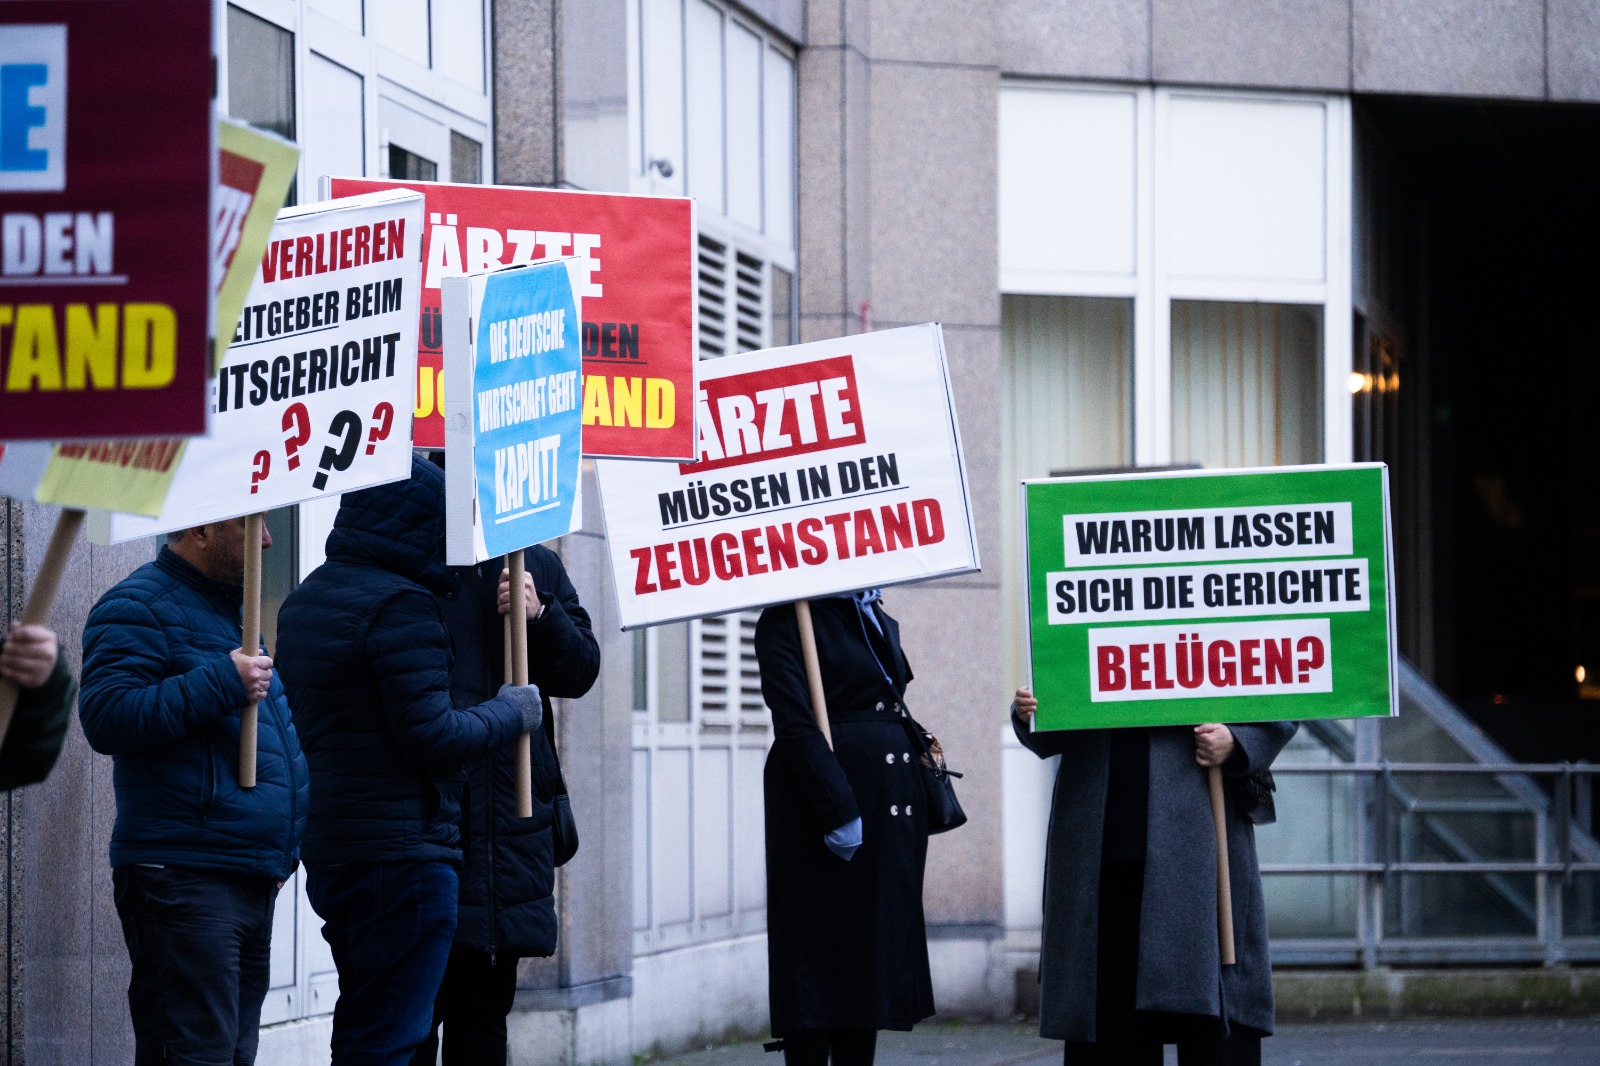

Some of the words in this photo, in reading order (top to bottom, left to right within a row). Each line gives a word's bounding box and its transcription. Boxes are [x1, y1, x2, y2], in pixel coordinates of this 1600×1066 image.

[2, 212, 114, 276] DEN
[261, 218, 406, 284] VERLIEREN
[345, 278, 403, 321] BEIM
[489, 321, 508, 365] DIE
[509, 308, 565, 360] DEUTSCHE
[581, 321, 639, 359] DEN
[211, 332, 401, 415] ITSGERICHT
[477, 377, 547, 434] WIRTSCHAFT
[548, 370, 577, 416] GEHT
[494, 434, 561, 515] KAPUTT
[658, 472, 790, 526] MÜSSEN
[796, 466, 832, 501] IN
[838, 453, 900, 494] DEN
[629, 497, 946, 595] ZEUGENSTAND
[1075, 516, 1206, 555] WARUM
[1214, 510, 1335, 549] LASSEN
[1055, 577, 1134, 614] SICH
[1143, 575, 1195, 610] DIE
[1202, 567, 1362, 607] GERICHTE
[1096, 633, 1325, 692] BELÜGEN?
